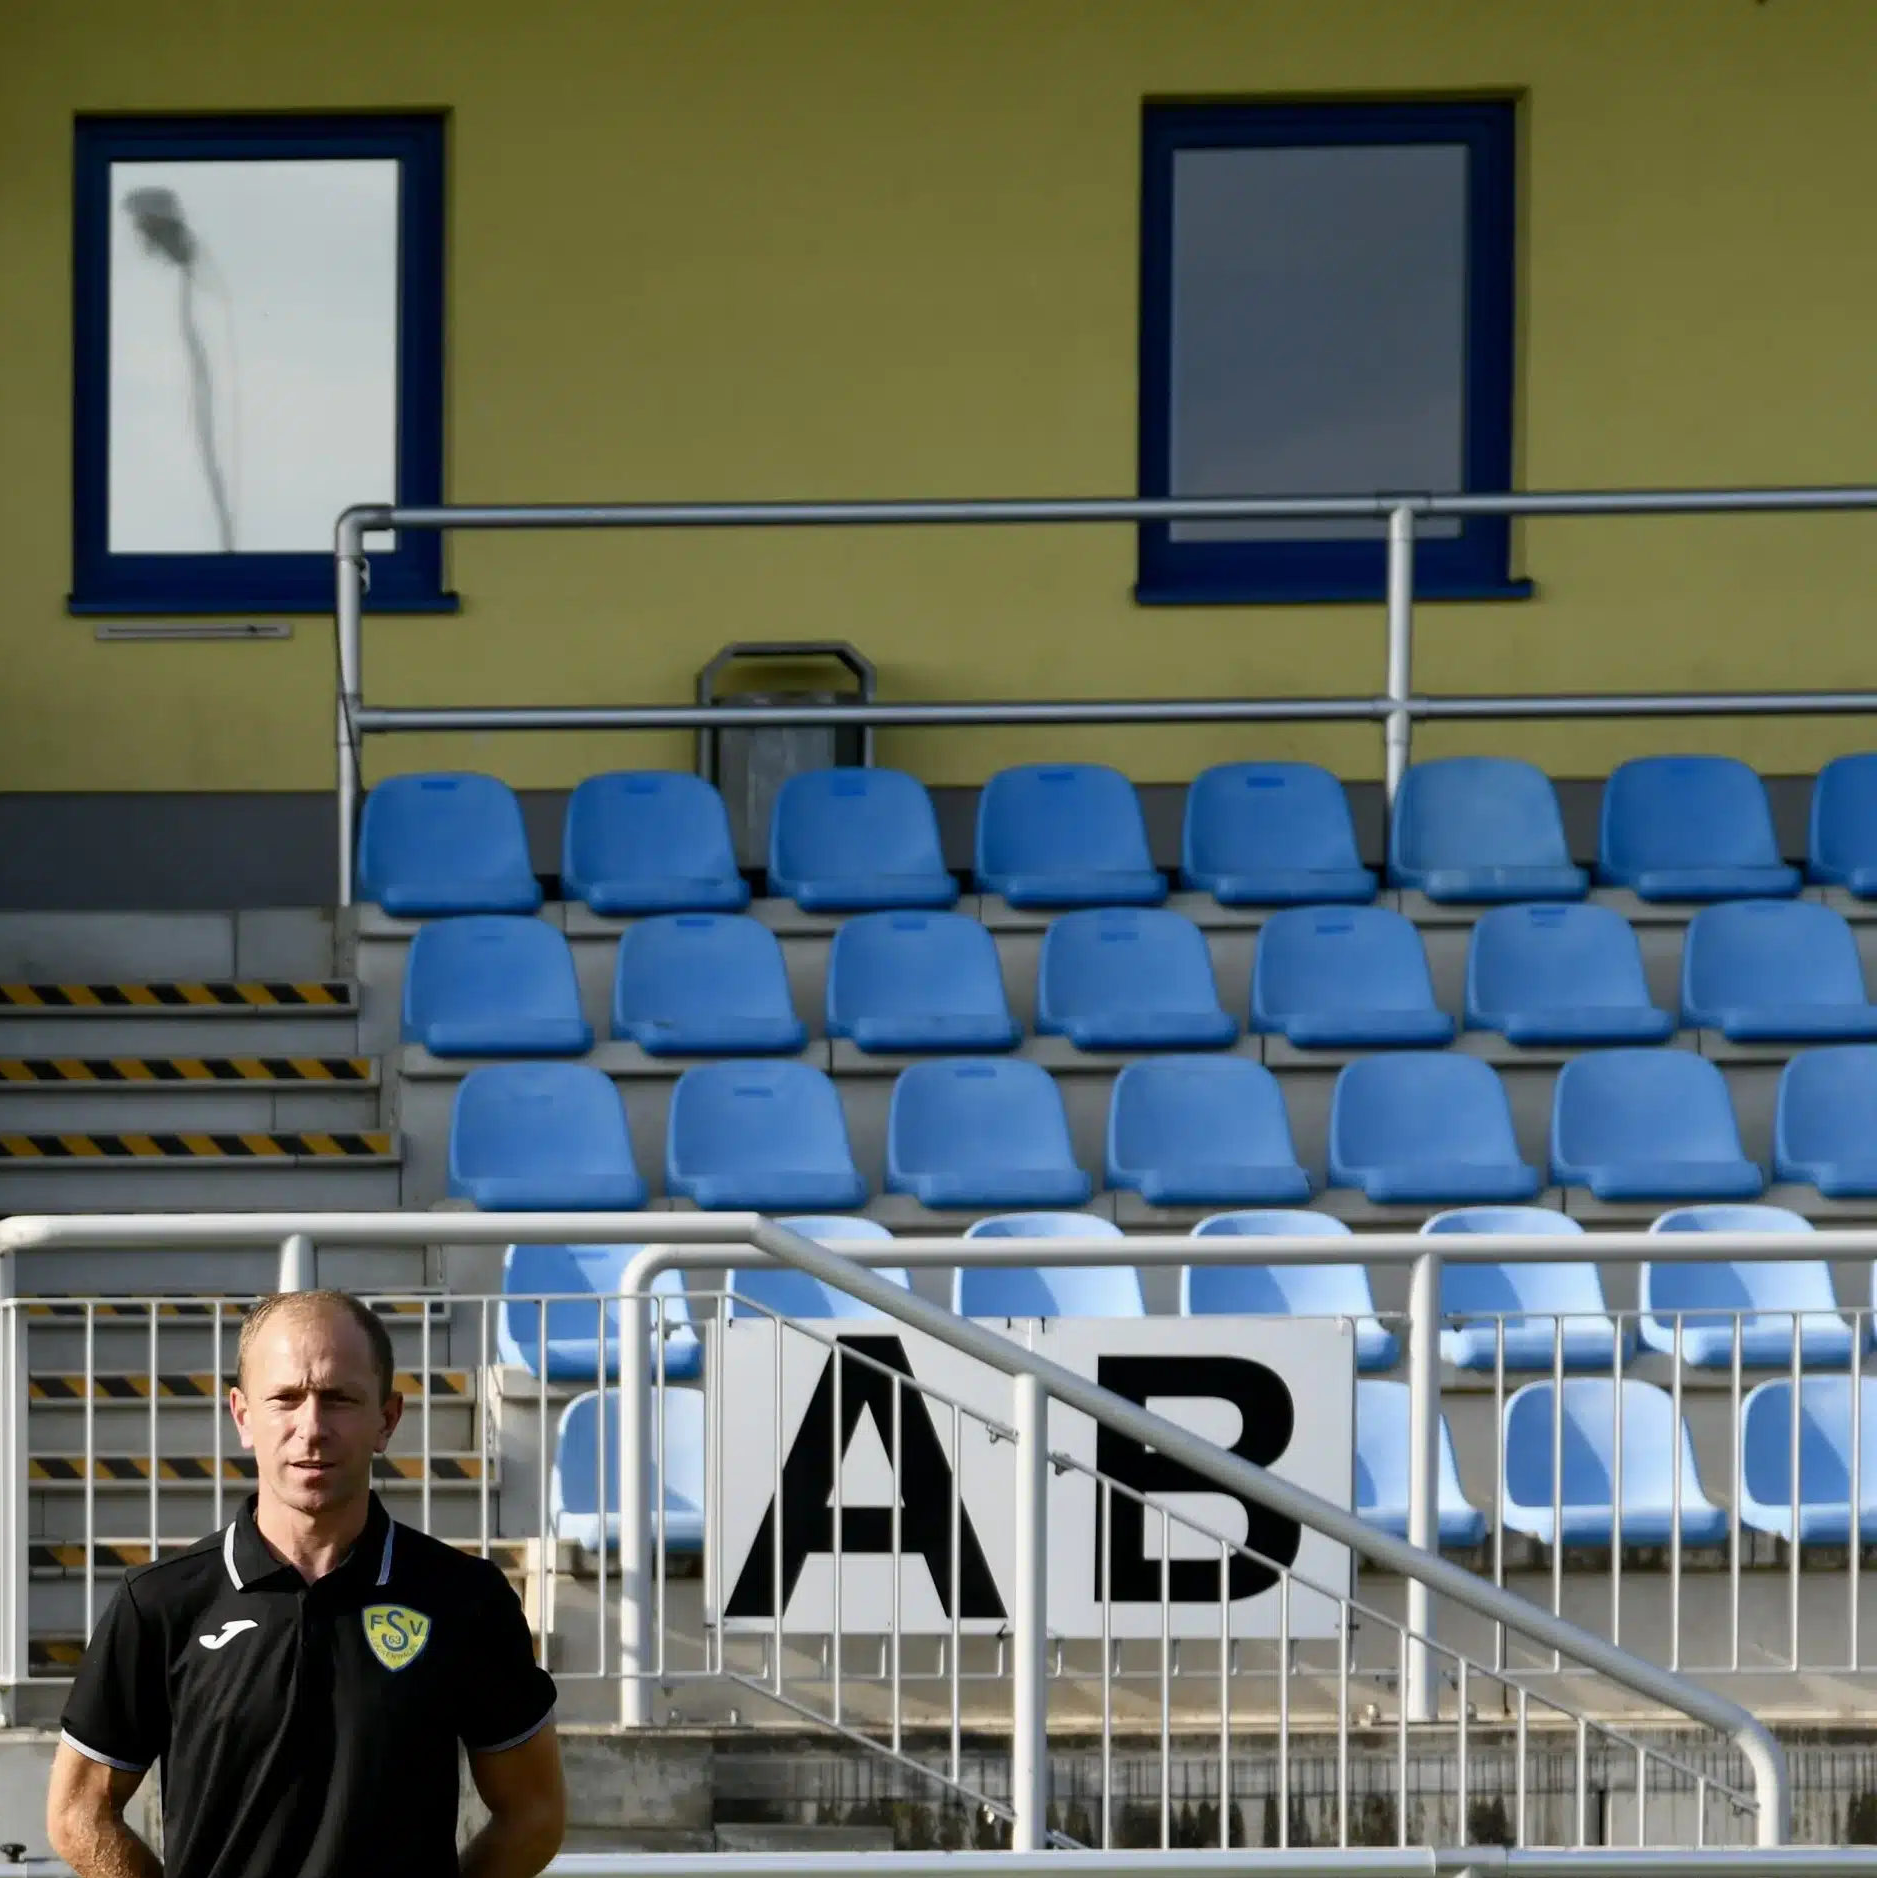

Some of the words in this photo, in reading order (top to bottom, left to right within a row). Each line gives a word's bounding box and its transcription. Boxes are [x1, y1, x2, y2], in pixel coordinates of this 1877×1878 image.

[724, 1334, 1008, 1619] A
[1094, 1354, 1302, 1604] B
[371, 1610, 423, 1651] FSV
